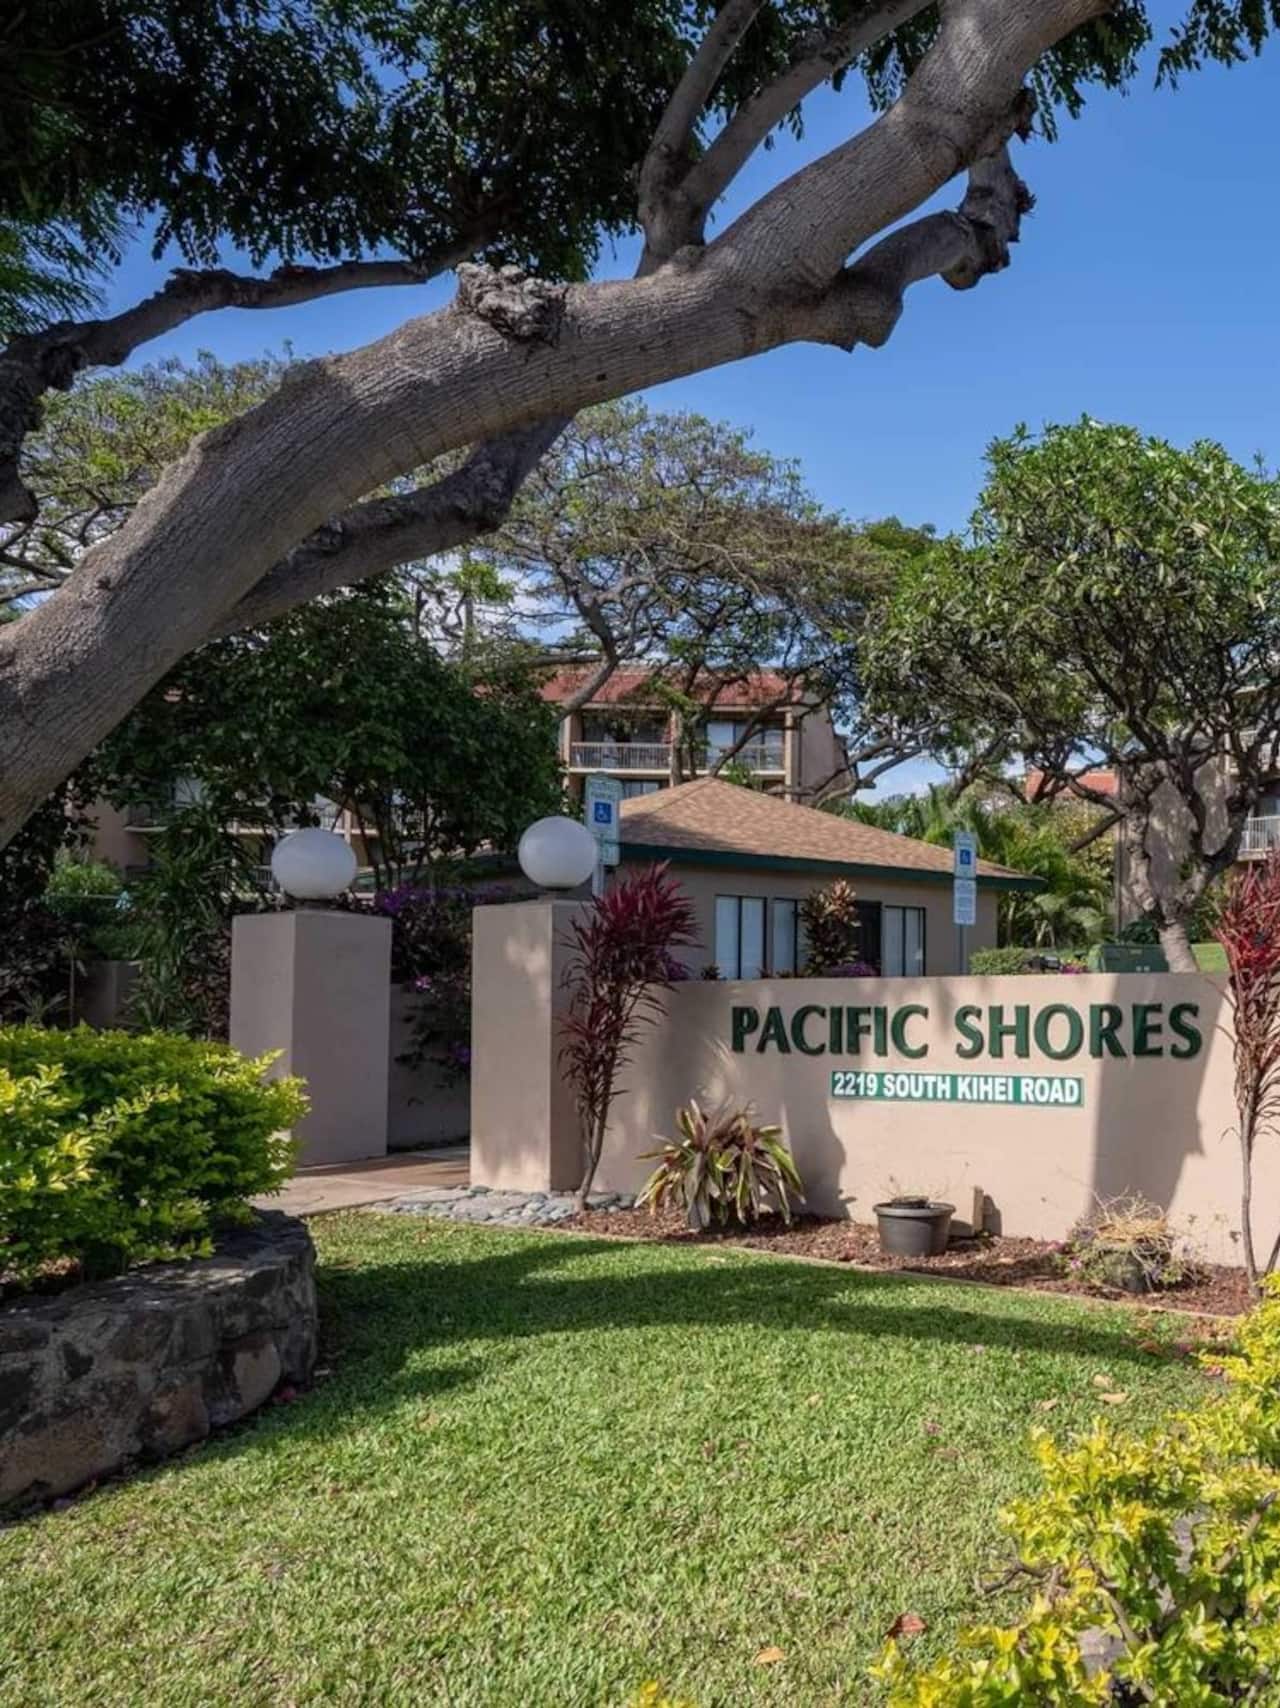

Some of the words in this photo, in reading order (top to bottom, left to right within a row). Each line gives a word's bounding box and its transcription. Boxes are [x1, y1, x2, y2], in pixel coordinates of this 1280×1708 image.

[731, 1004, 929, 1059] PACIFIC
[954, 1003, 1203, 1061] SHORES
[833, 1072, 878, 1096] 2219
[883, 1074, 951, 1099] SOUTH
[957, 1076, 1014, 1101] KIHEI
[1020, 1078, 1080, 1103] ROAD
